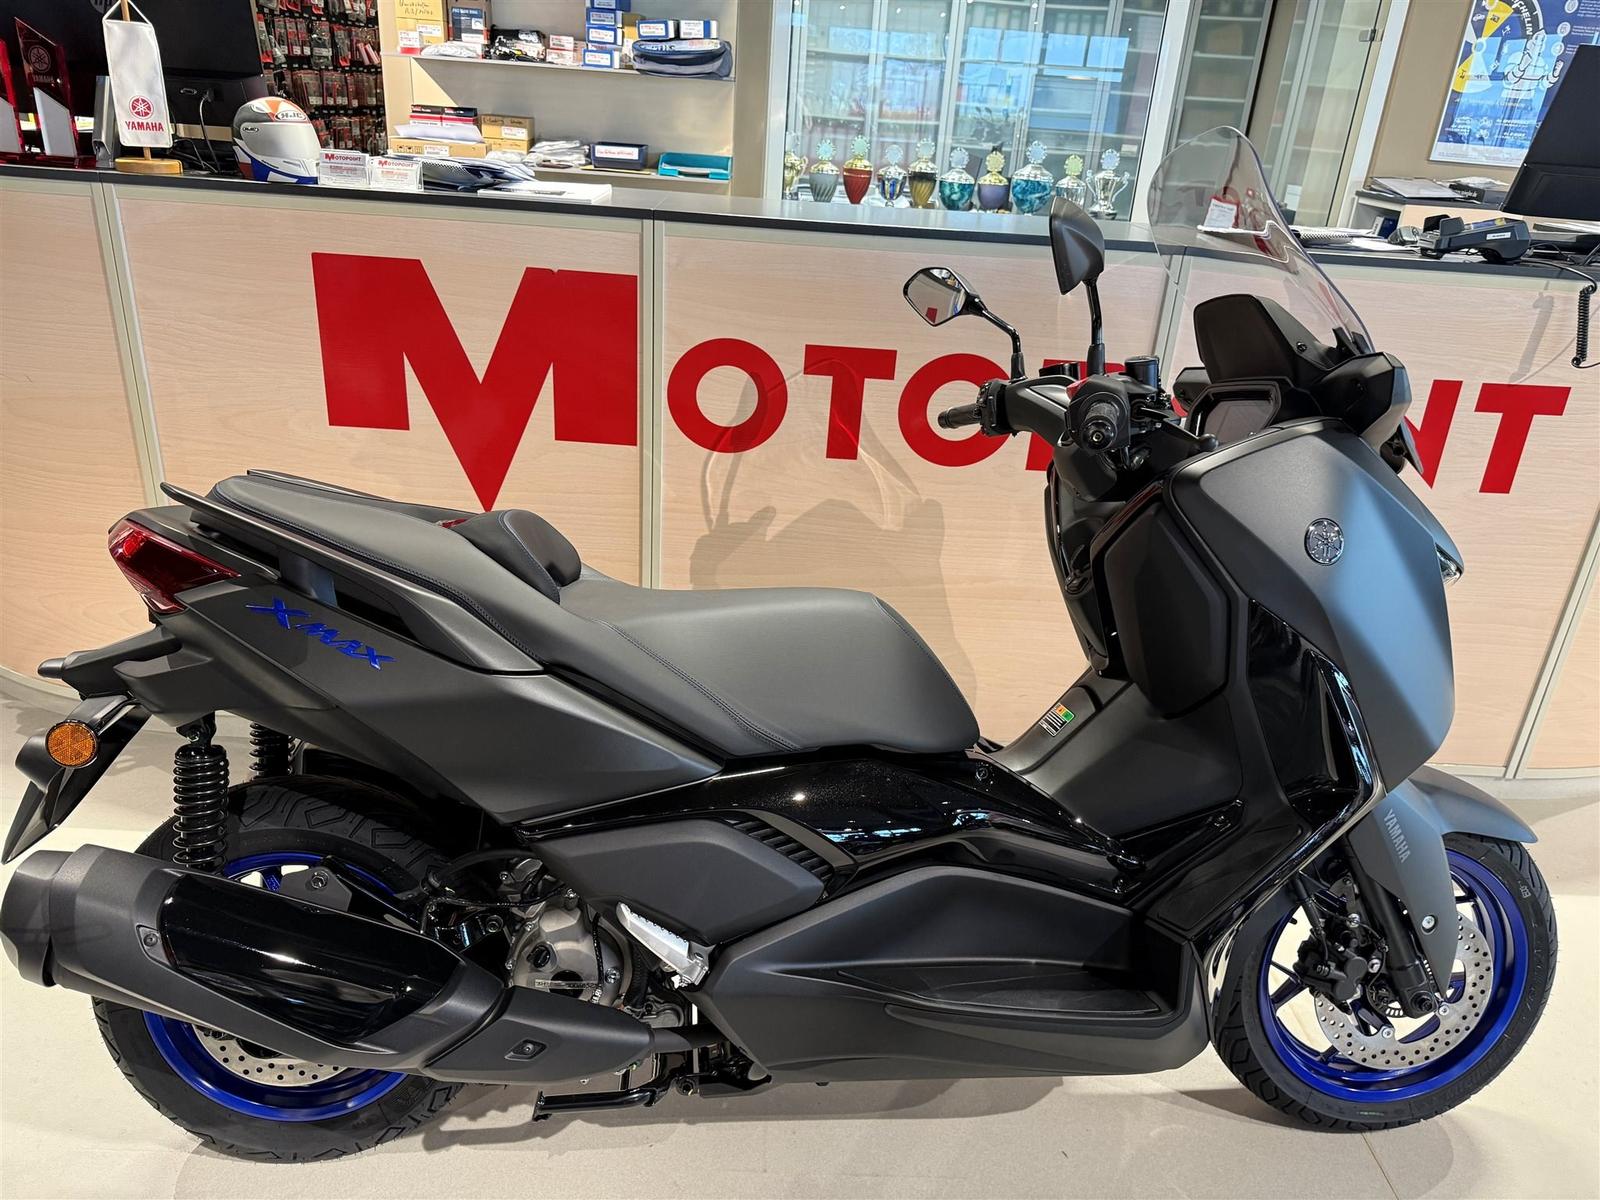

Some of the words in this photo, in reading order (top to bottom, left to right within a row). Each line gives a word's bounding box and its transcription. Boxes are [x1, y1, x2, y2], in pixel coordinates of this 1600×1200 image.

[125, 120, 164, 132] YAMAHA
[324, 153, 361, 161] MOTOPOINT
[1383, 808, 1411, 863] YAMAHA
